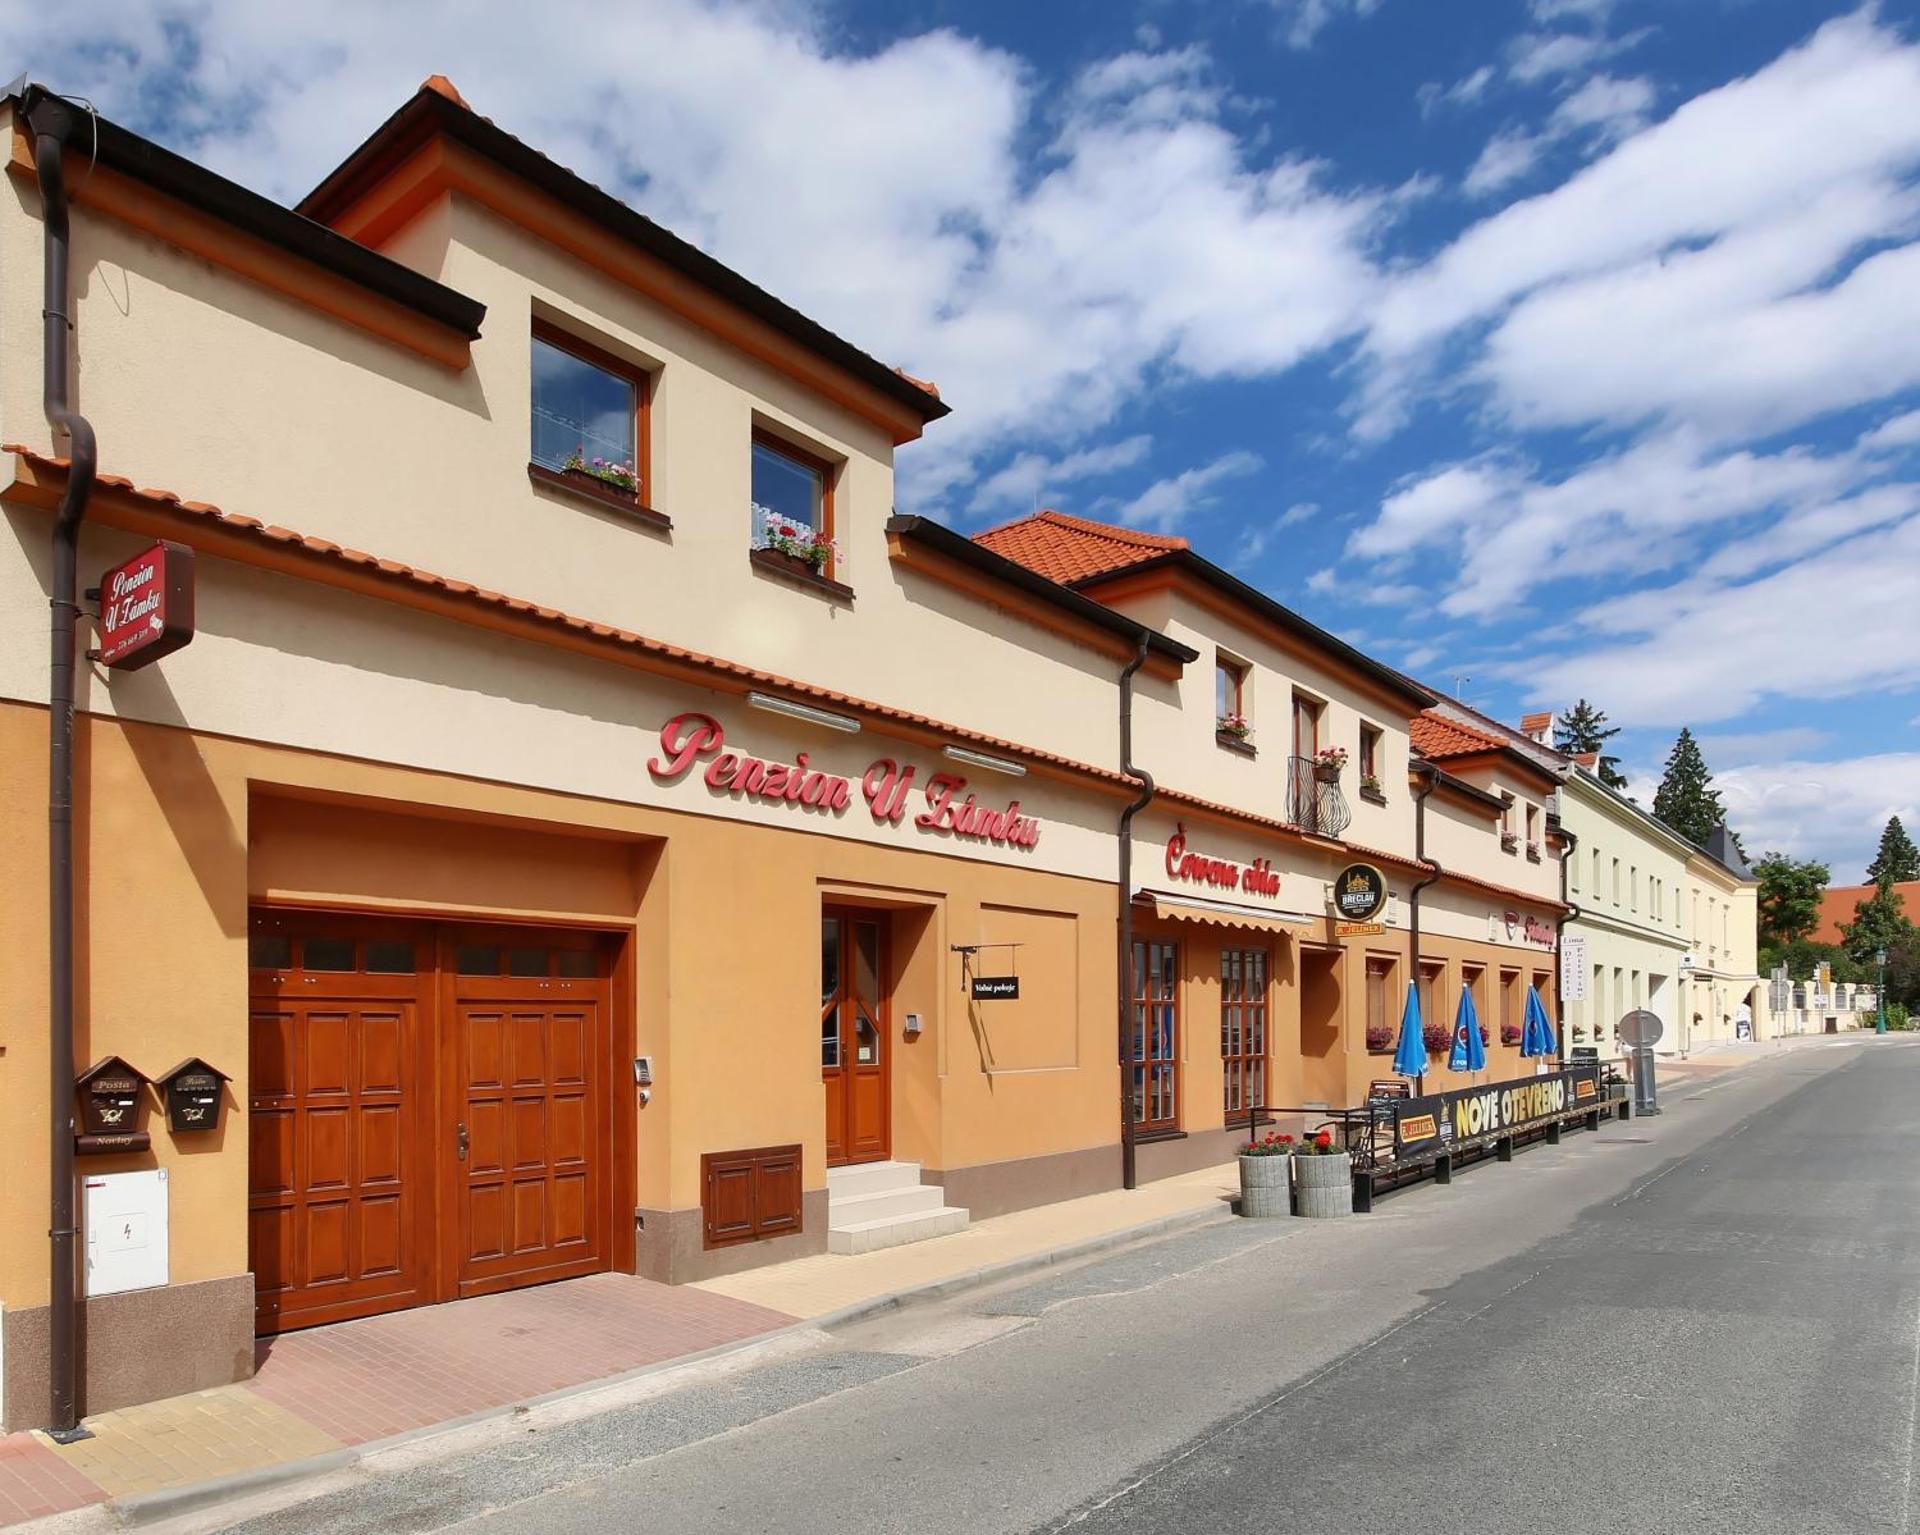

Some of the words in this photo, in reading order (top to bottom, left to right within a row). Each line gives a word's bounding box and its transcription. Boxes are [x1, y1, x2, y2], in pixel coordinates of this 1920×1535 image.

[111, 564, 154, 601] Penzion
[105, 603, 119, 633] U
[118, 589, 161, 626] Zámku
[647, 712, 852, 814] Penzion
[862, 758, 916, 821] U
[915, 772, 1040, 848] Zámku
